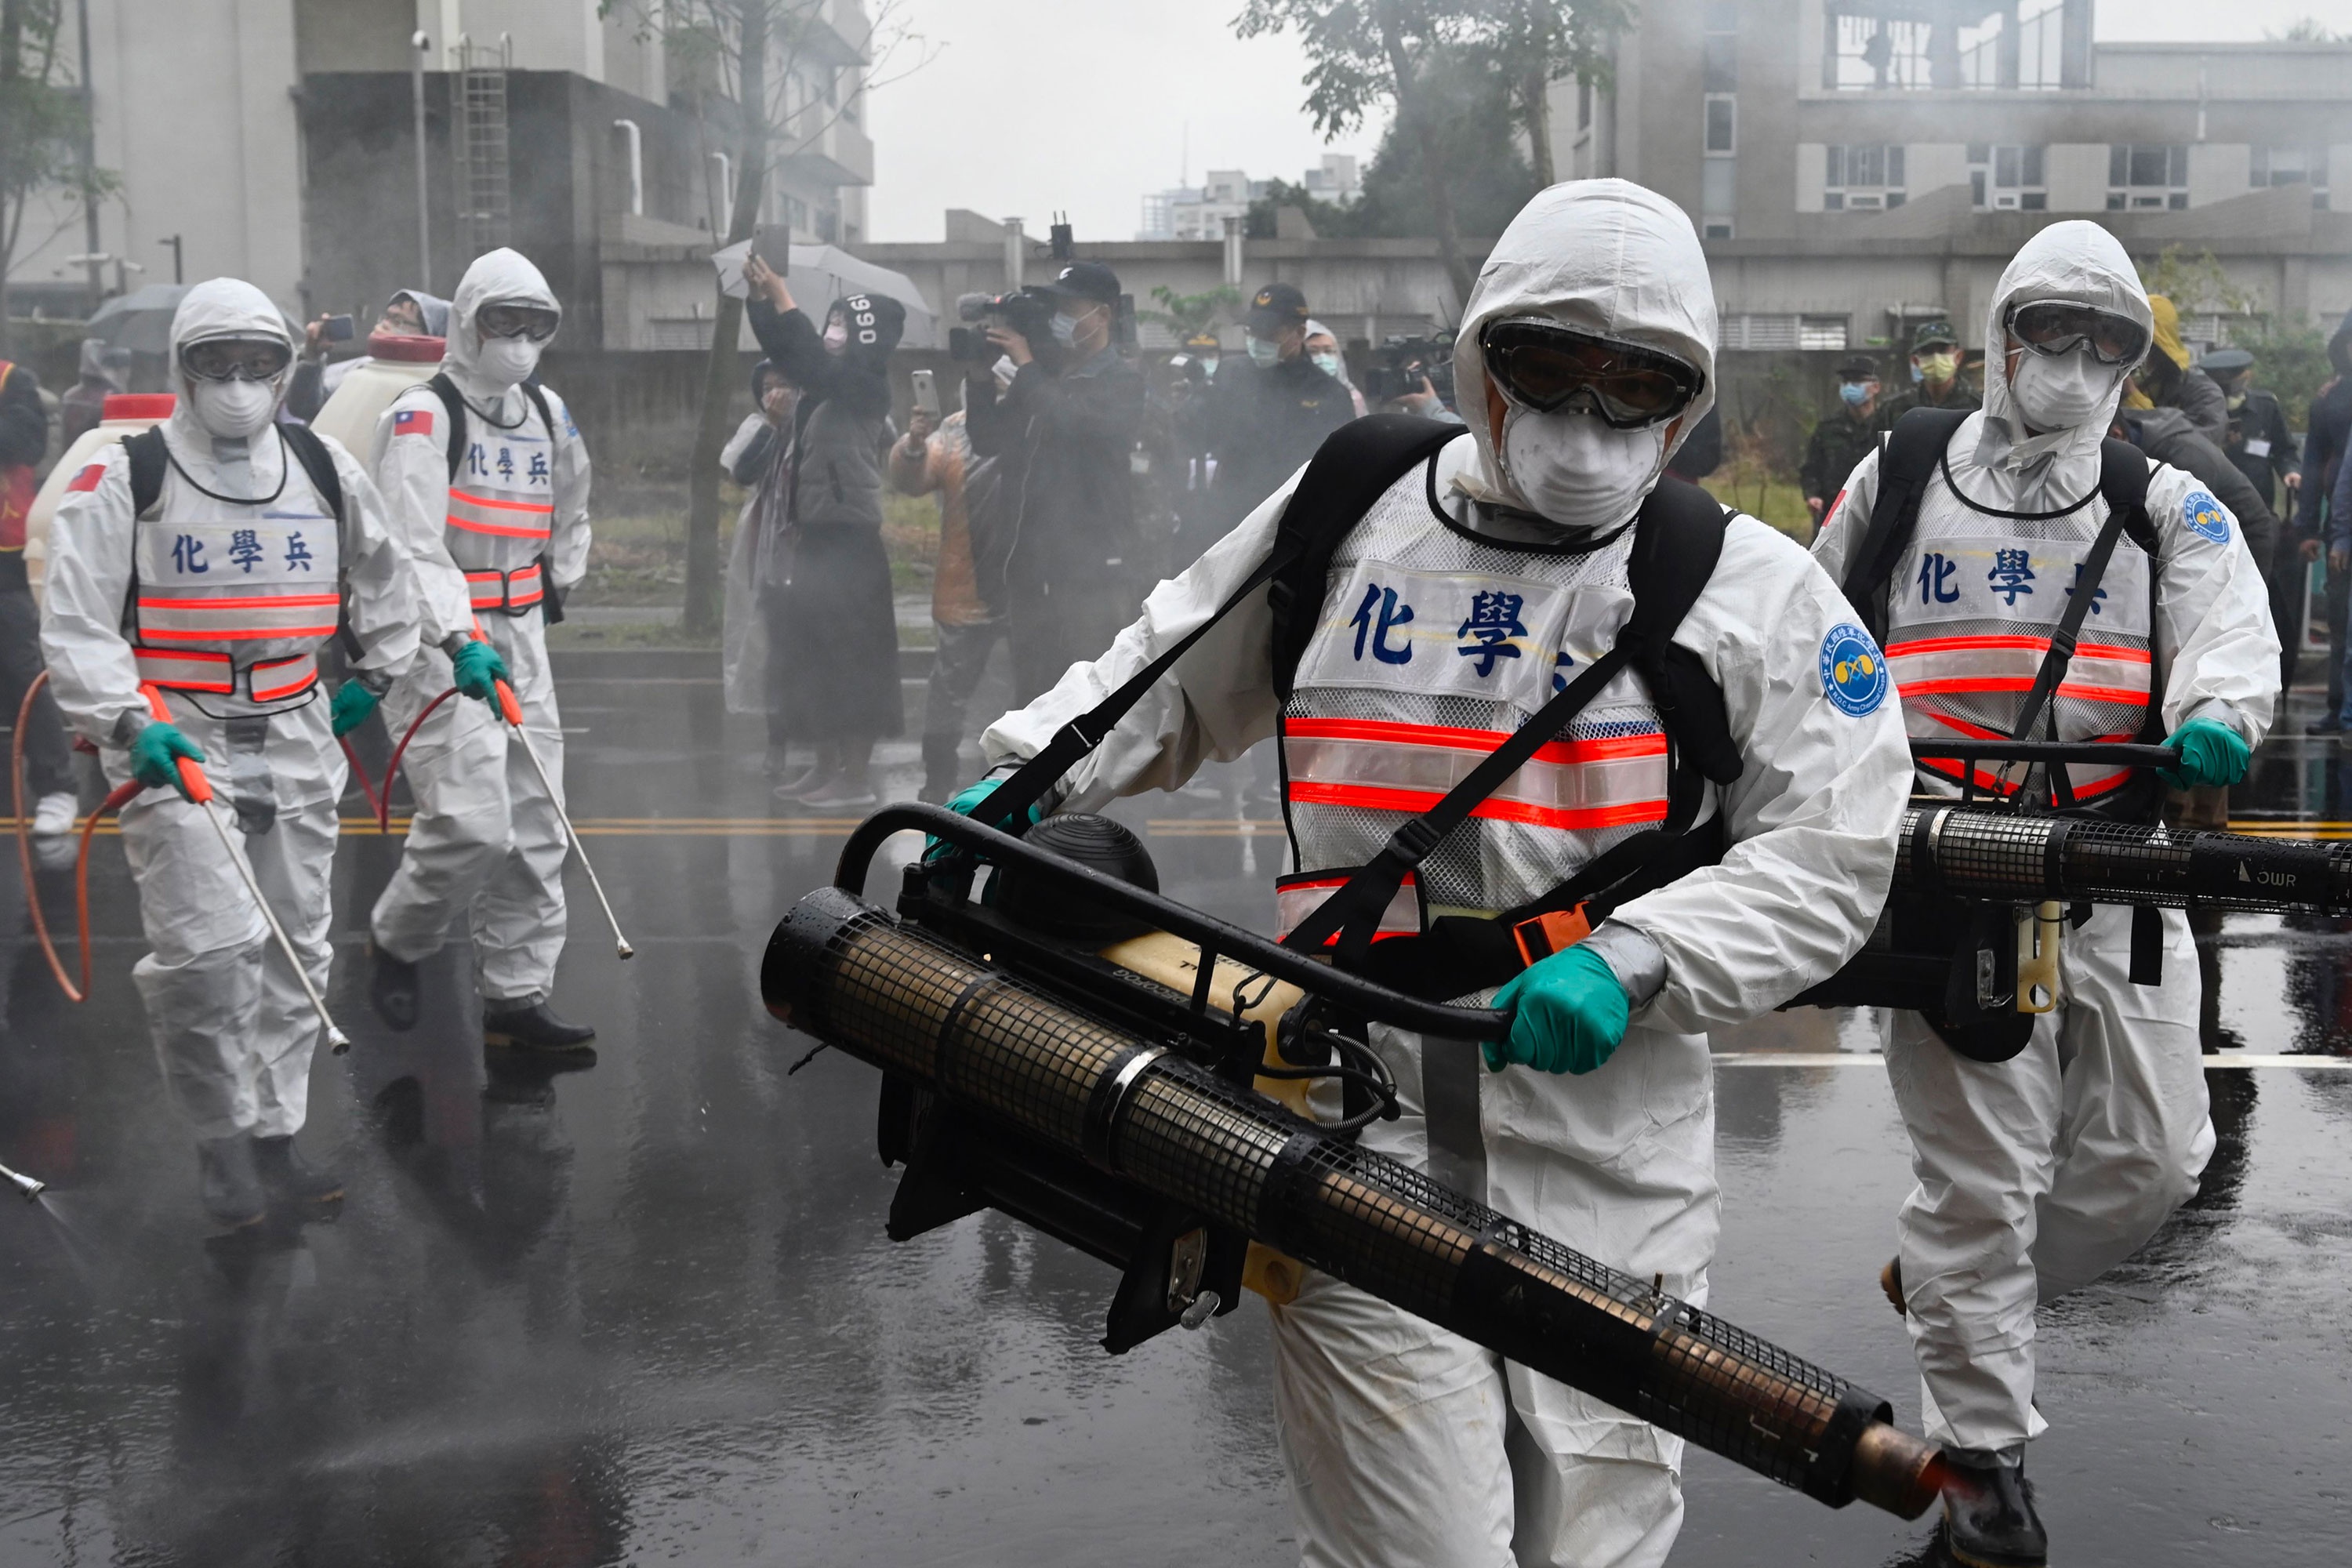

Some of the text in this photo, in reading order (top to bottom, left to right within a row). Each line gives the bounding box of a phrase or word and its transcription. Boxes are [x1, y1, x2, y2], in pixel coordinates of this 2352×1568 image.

[468, 443, 549, 485] 化學兵
[171, 529, 313, 574] 化學兵
[1349, 583, 1574, 693] 化學
[1847, 704, 1860, 713] Army
[1878, 674, 1886, 694] Corps
[1112, 968, 1190, 1004] DECOFOG
